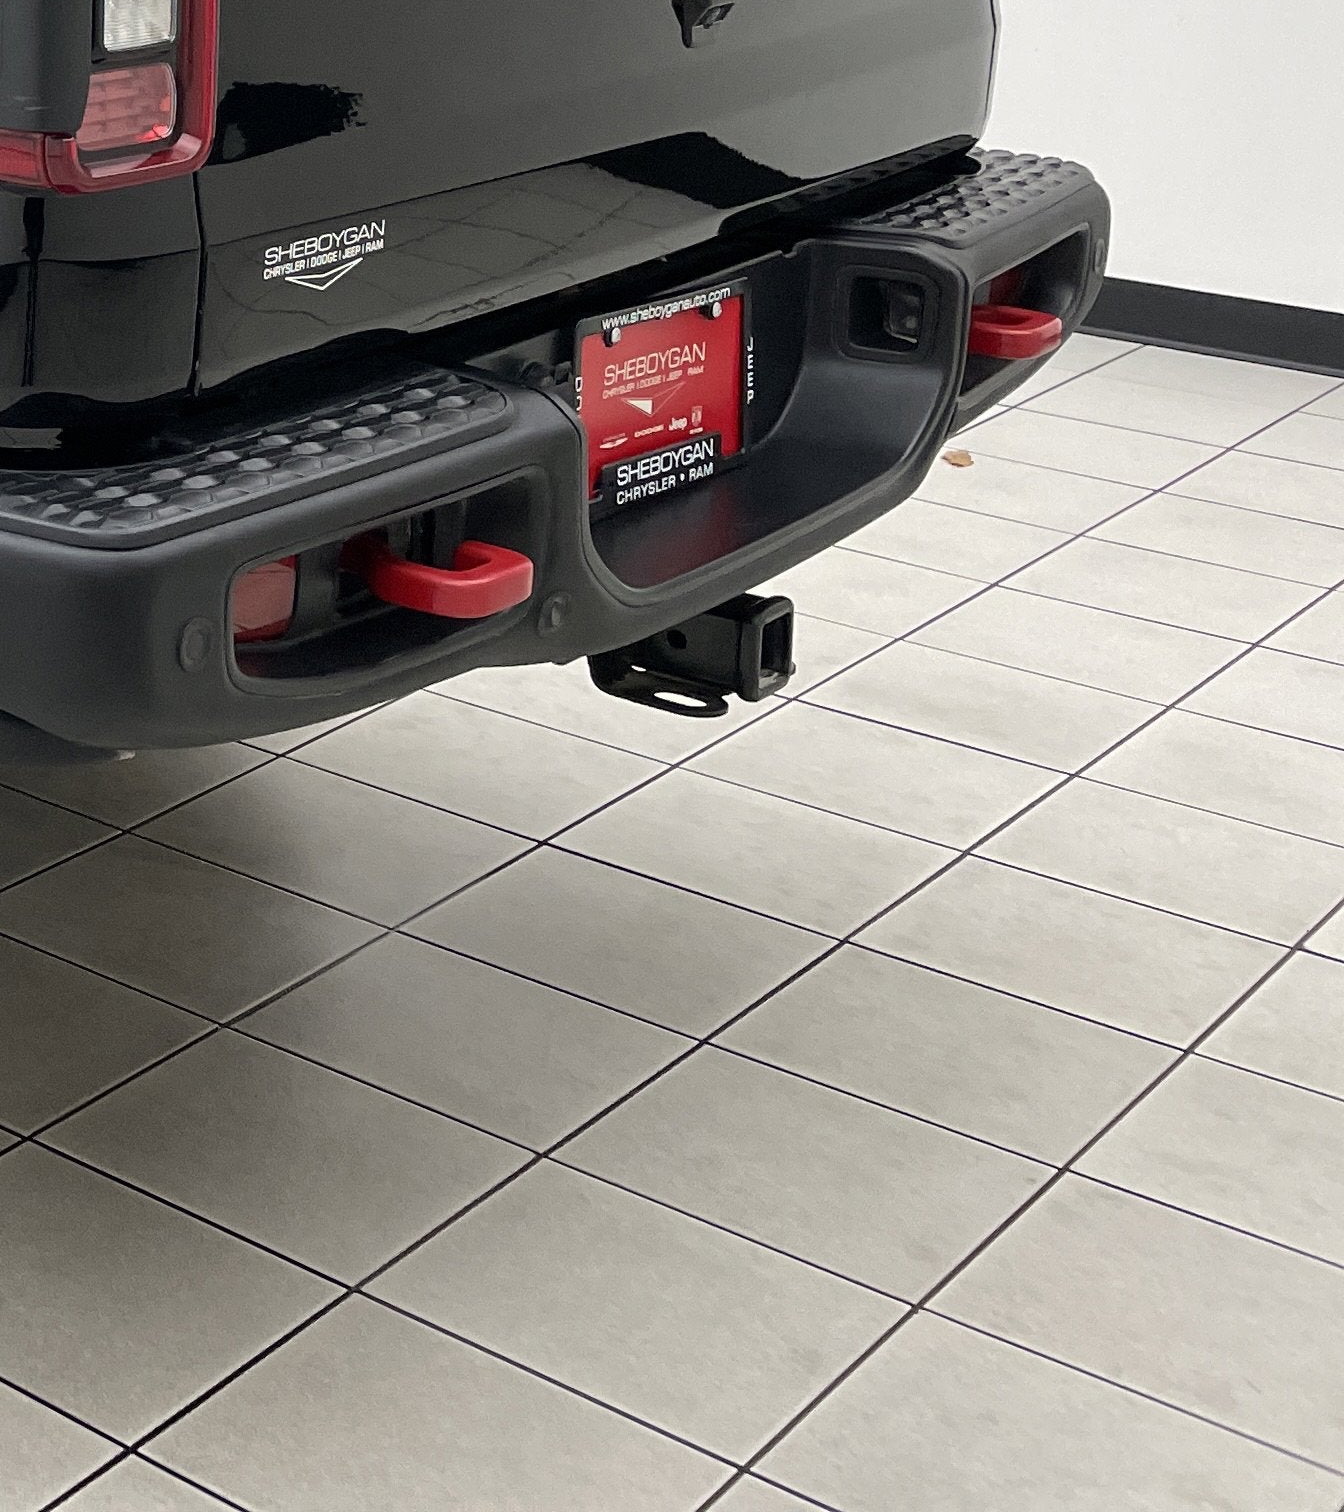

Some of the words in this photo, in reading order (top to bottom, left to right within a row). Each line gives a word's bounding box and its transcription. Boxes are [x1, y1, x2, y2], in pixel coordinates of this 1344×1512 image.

[263, 259, 306, 280] CHRYSLER
[311, 251, 338, 268] DODGE
[342, 245, 361, 260] JEEP
[365, 238, 384, 254] RAM
[264, 219, 386, 266] SHEBOYGAN
[601, 287, 731, 330] www.sheboyganauto.com
[604, 342, 706, 386] SHEBOYGAN
[746, 337, 754, 404] JEEP
[616, 438, 714, 486] SHEBOYGAN
[616, 475, 676, 505] CHRYSLER
[689, 462, 714, 482] RAM
